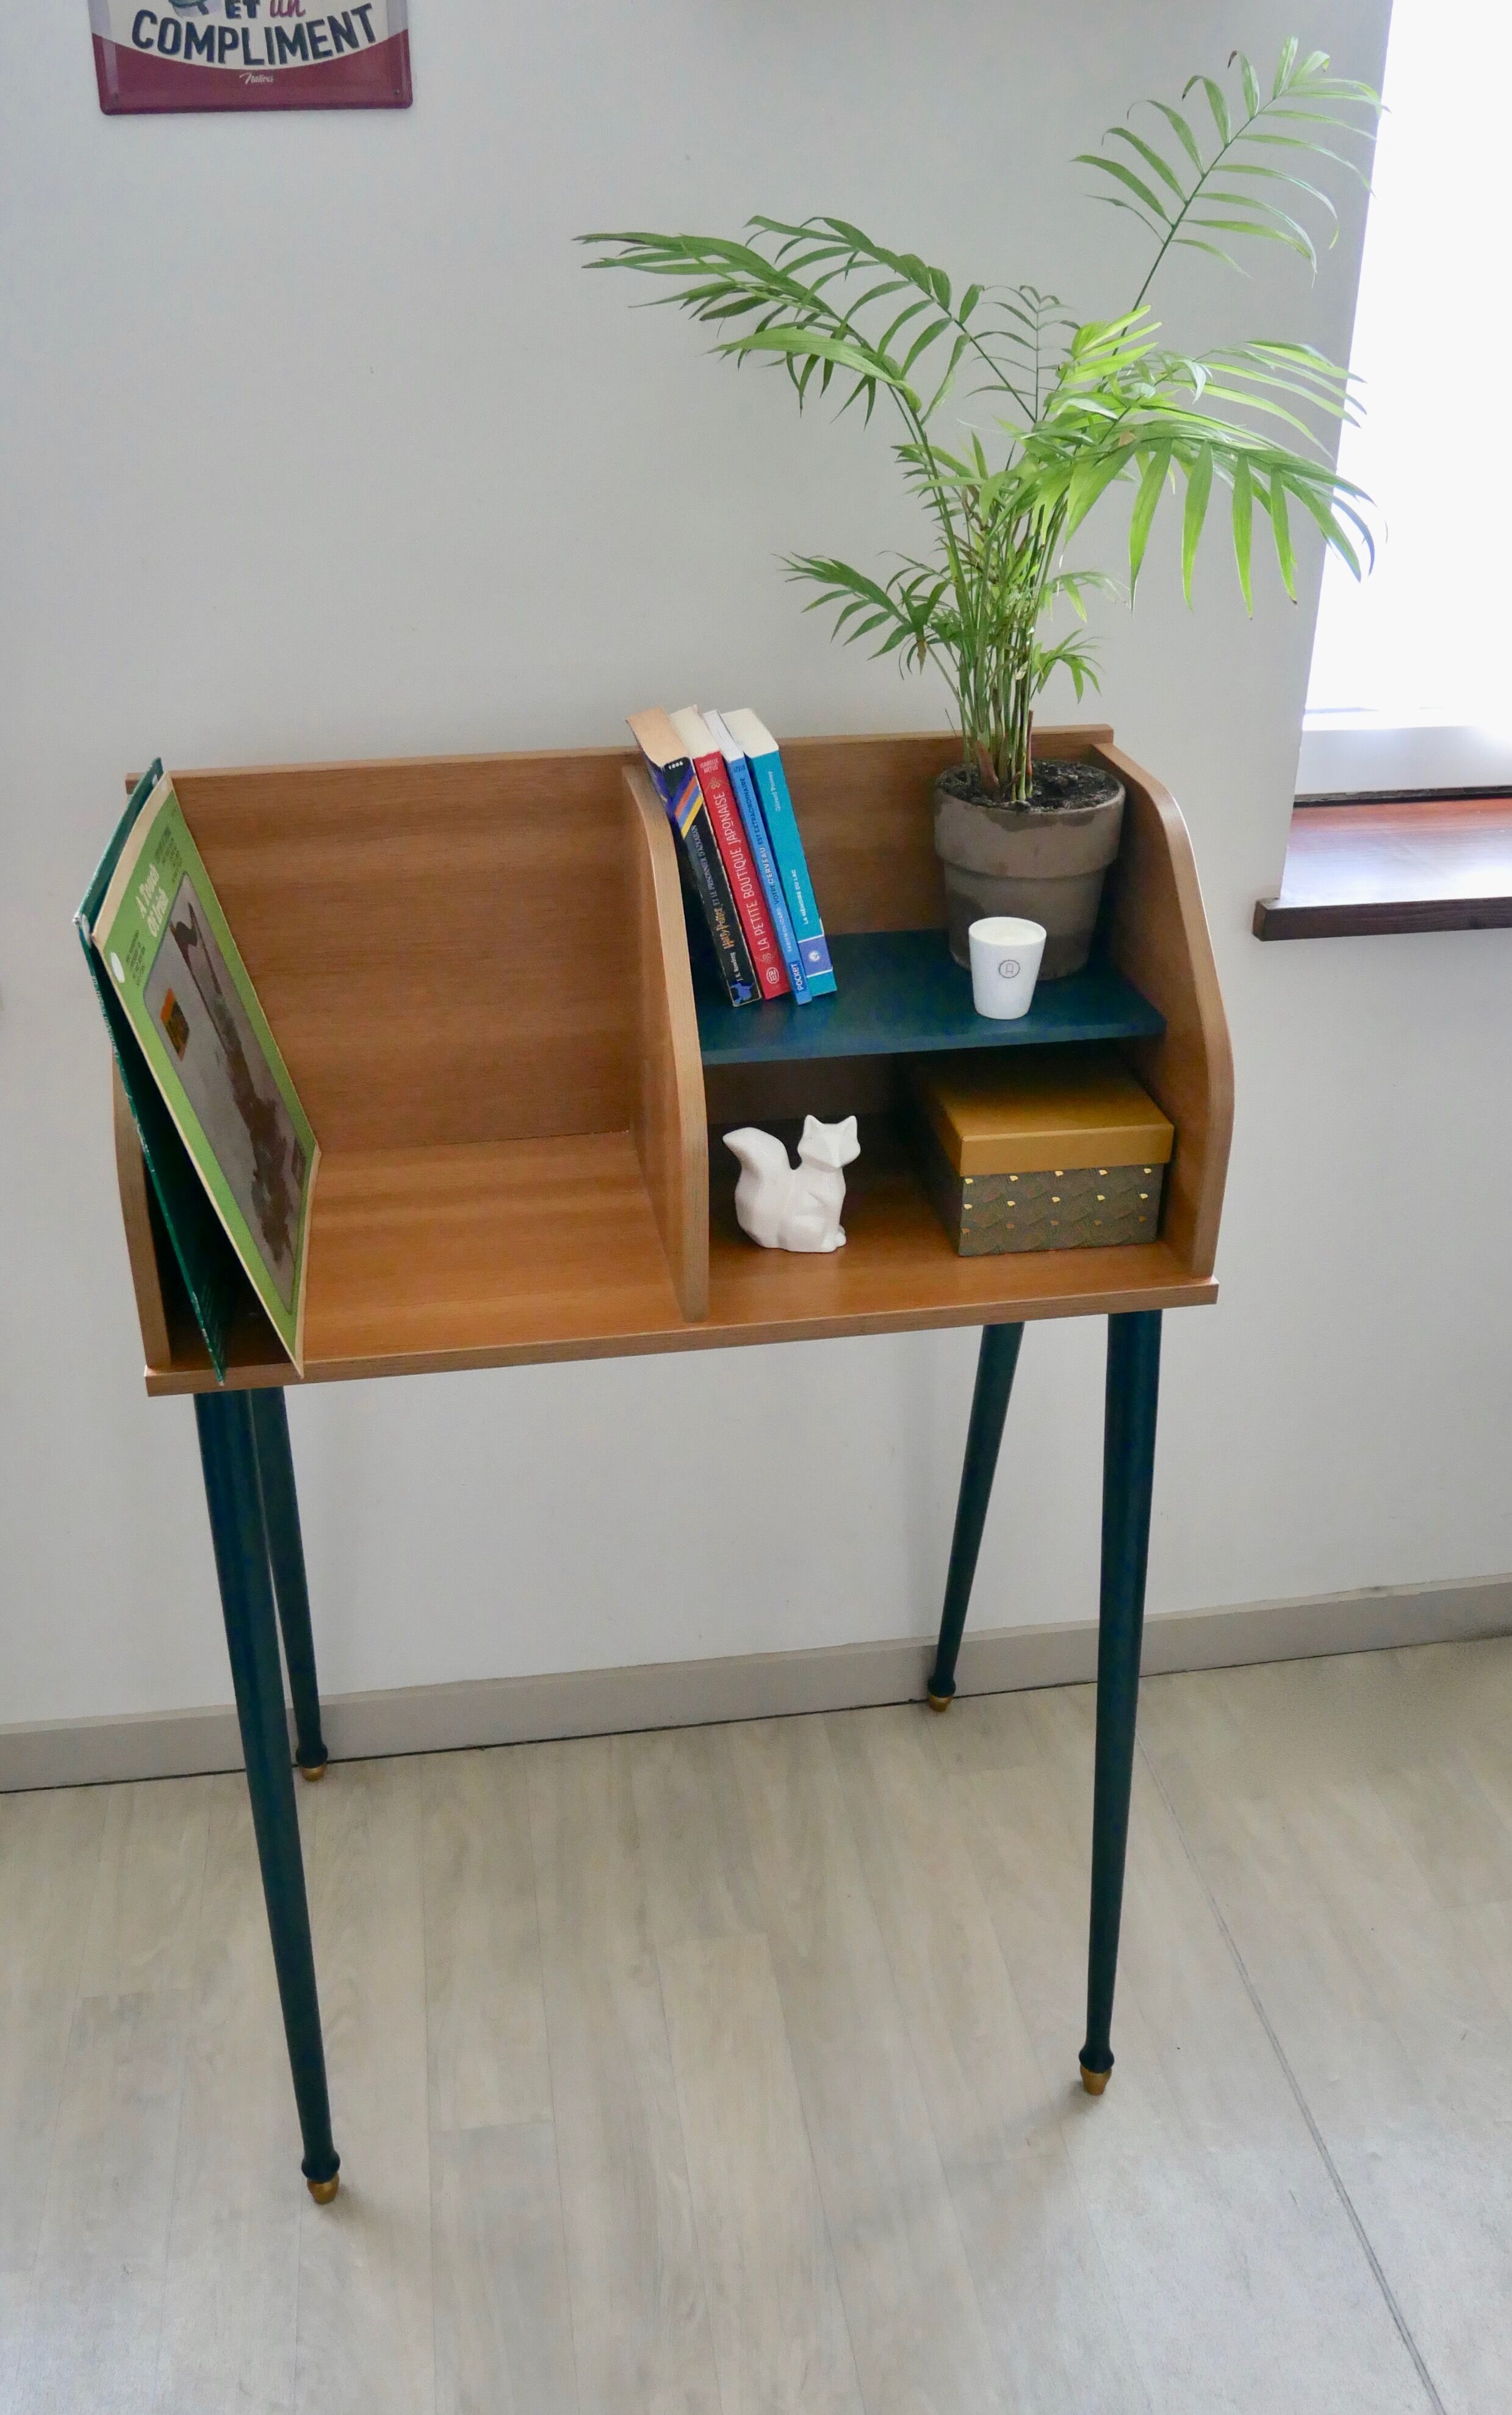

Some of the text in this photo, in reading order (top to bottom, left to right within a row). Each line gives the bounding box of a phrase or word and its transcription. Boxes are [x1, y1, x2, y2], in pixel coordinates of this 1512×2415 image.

[226, 0, 306, 19] ET un
[131, 2, 376, 66] COMPLIMENT
[740, 778, 760, 833] EXTRAORDINAIRE
[700, 857, 714, 890] PRISONNIER
[713, 792, 770, 951] LA PETITE BOUTIQUE JAPONAISE
[759, 847, 774, 884] CERVEAU
[140, 864, 159, 906] Touch
[771, 884, 779, 904] VOTRE
[153, 887, 169, 925] Irish
[714, 908, 730, 931] Potter
[720, 930, 735, 949] Harry
